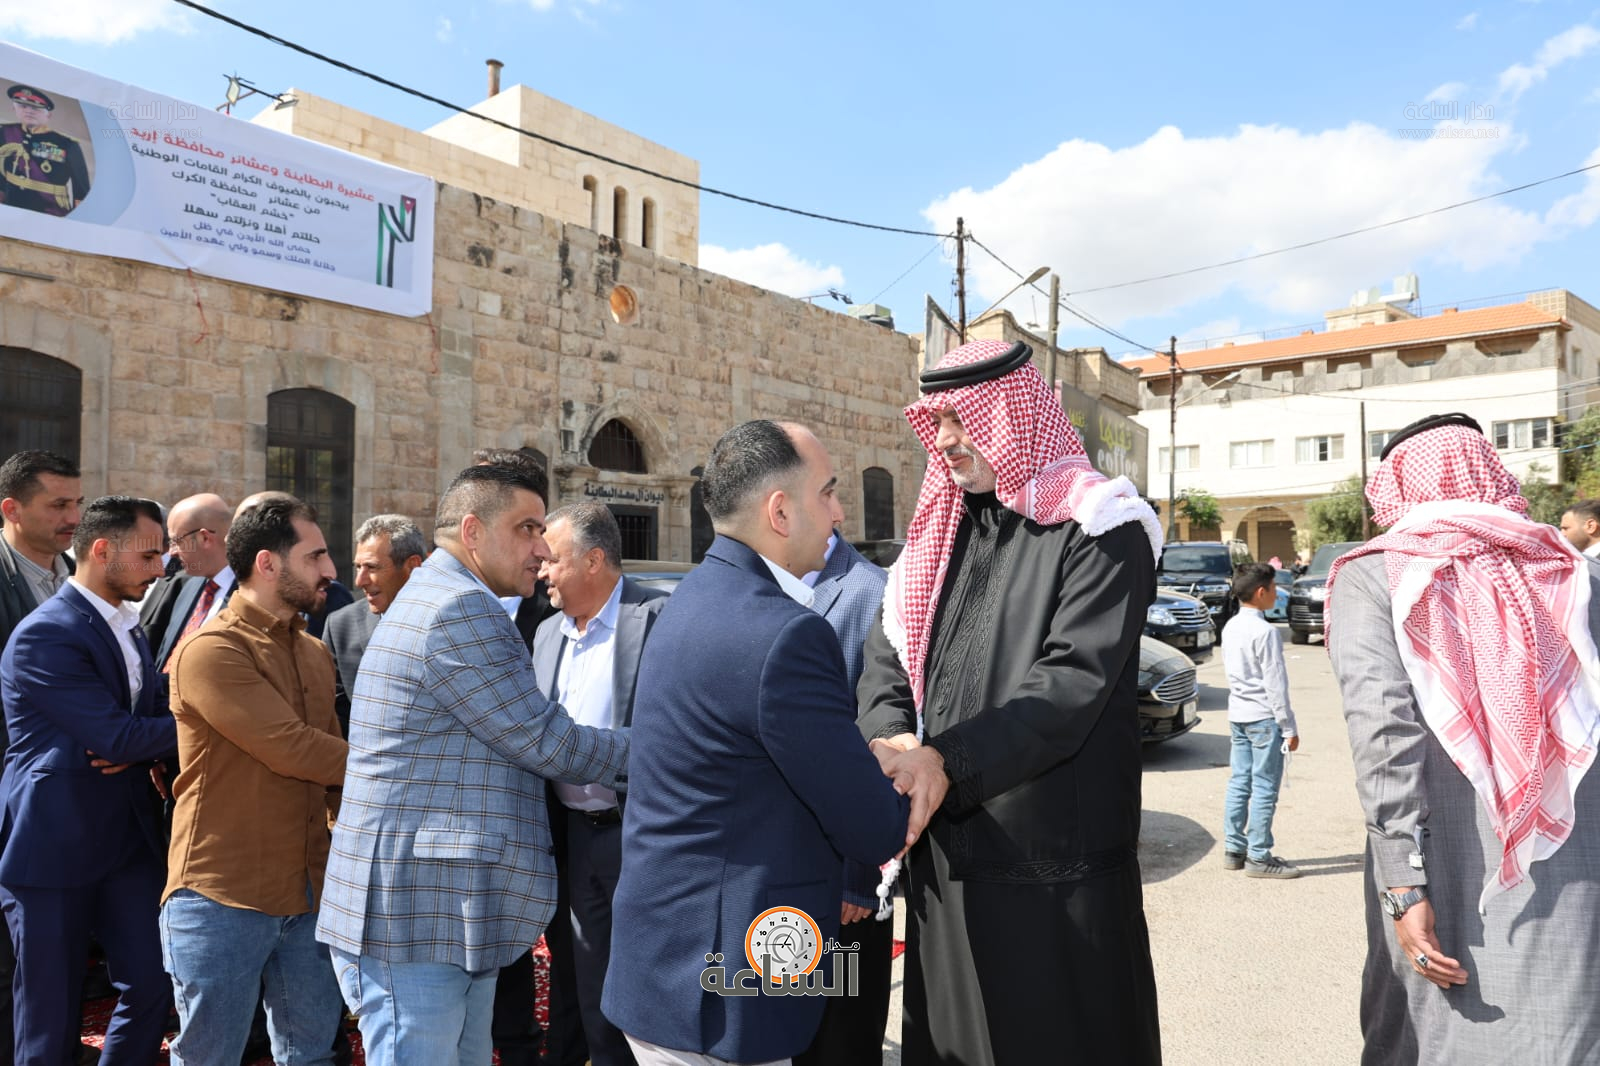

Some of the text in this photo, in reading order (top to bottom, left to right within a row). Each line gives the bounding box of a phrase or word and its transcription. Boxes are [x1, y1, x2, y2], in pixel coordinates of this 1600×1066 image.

[130, 127, 157, 144] إربد
[163, 133, 225, 159] محافظة
[131, 142, 350, 211] يرحبون بالضيوف الكرام القامات الوطنية
[171, 170, 206, 185] الكرك
[283, 167, 334, 190] البطاينة
[210, 178, 258, 198] محافظة
[337, 183, 375, 202] عشيرة
[303, 206, 321, 215] من
[184, 203, 321, 245] حللتم أهلا ونزلتم سهلا
[193, 221, 213, 231] ظل
[216, 227, 234, 237] في
[160, 227, 336, 272] جلالة الملك وسمو ولي عهده الأمين
[268, 238, 285, 248] الله
[584, 482, 617, 501] البطاينة
[644, 489, 664, 504] ديوان
